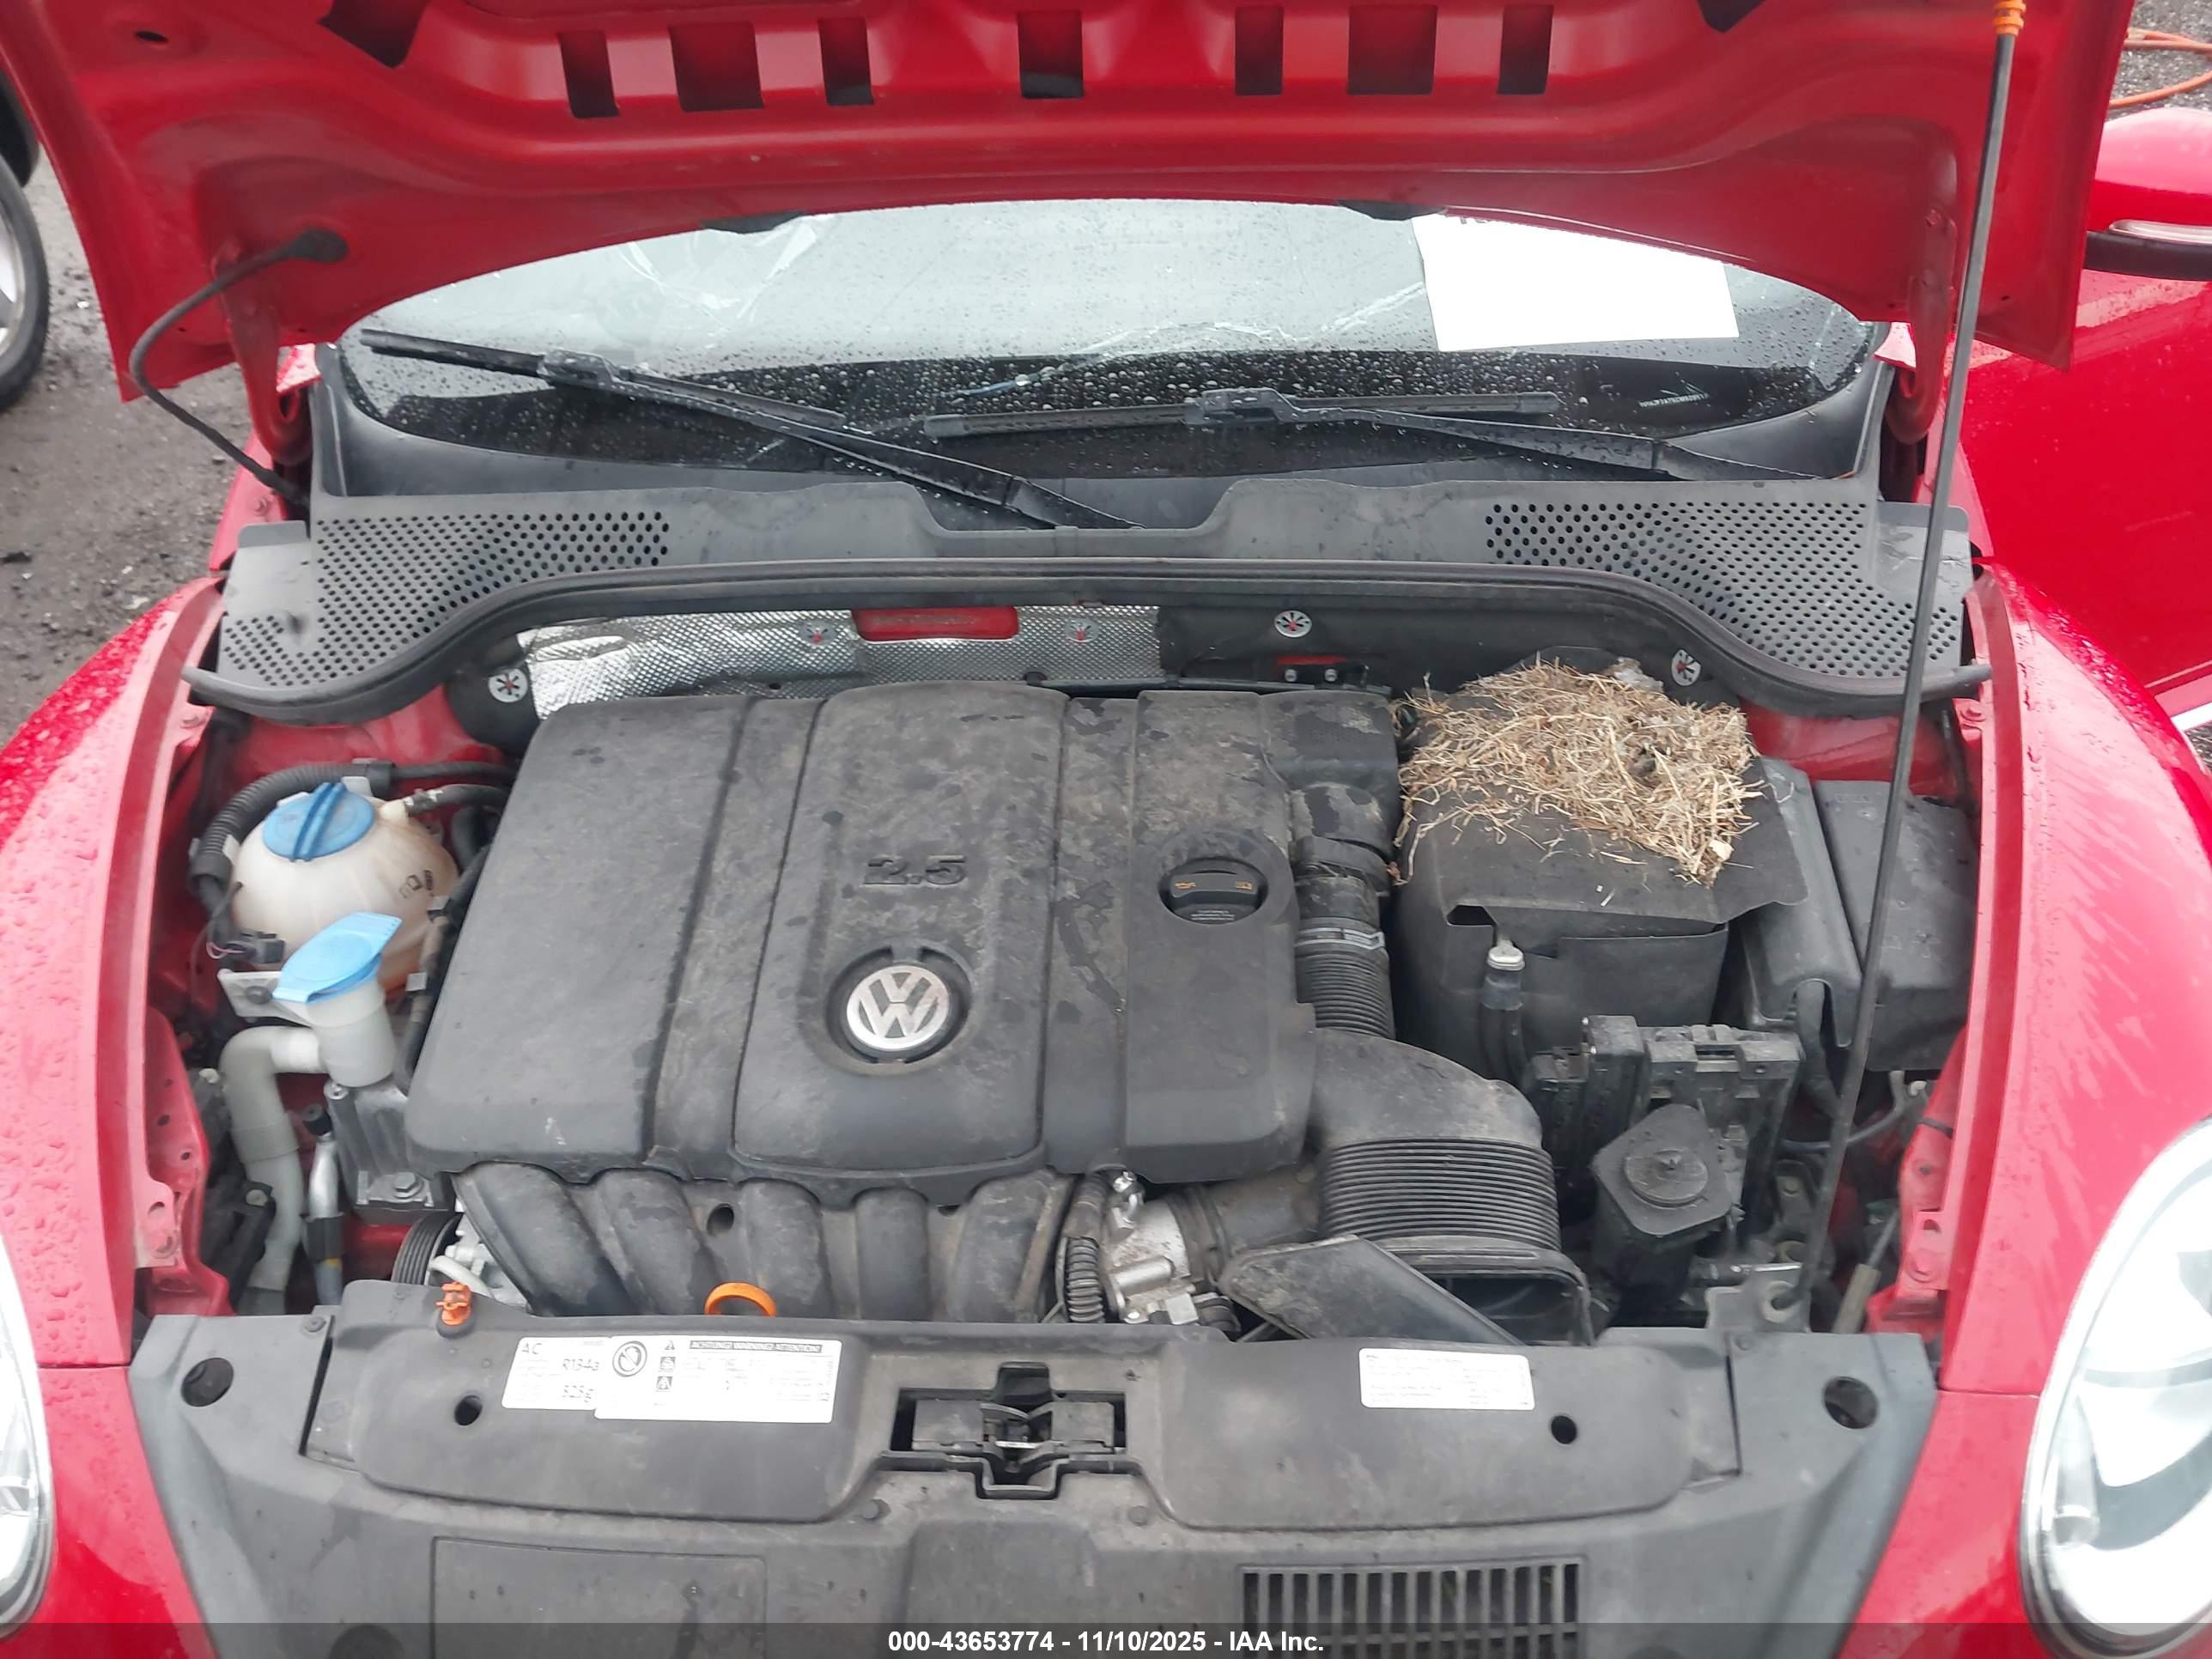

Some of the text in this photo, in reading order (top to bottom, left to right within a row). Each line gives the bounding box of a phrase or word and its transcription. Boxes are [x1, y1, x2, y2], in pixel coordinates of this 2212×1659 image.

[862, 855, 967, 886] 2.5
[852, 968, 945, 1045] VW
[521, 1342, 543, 1355] AC
